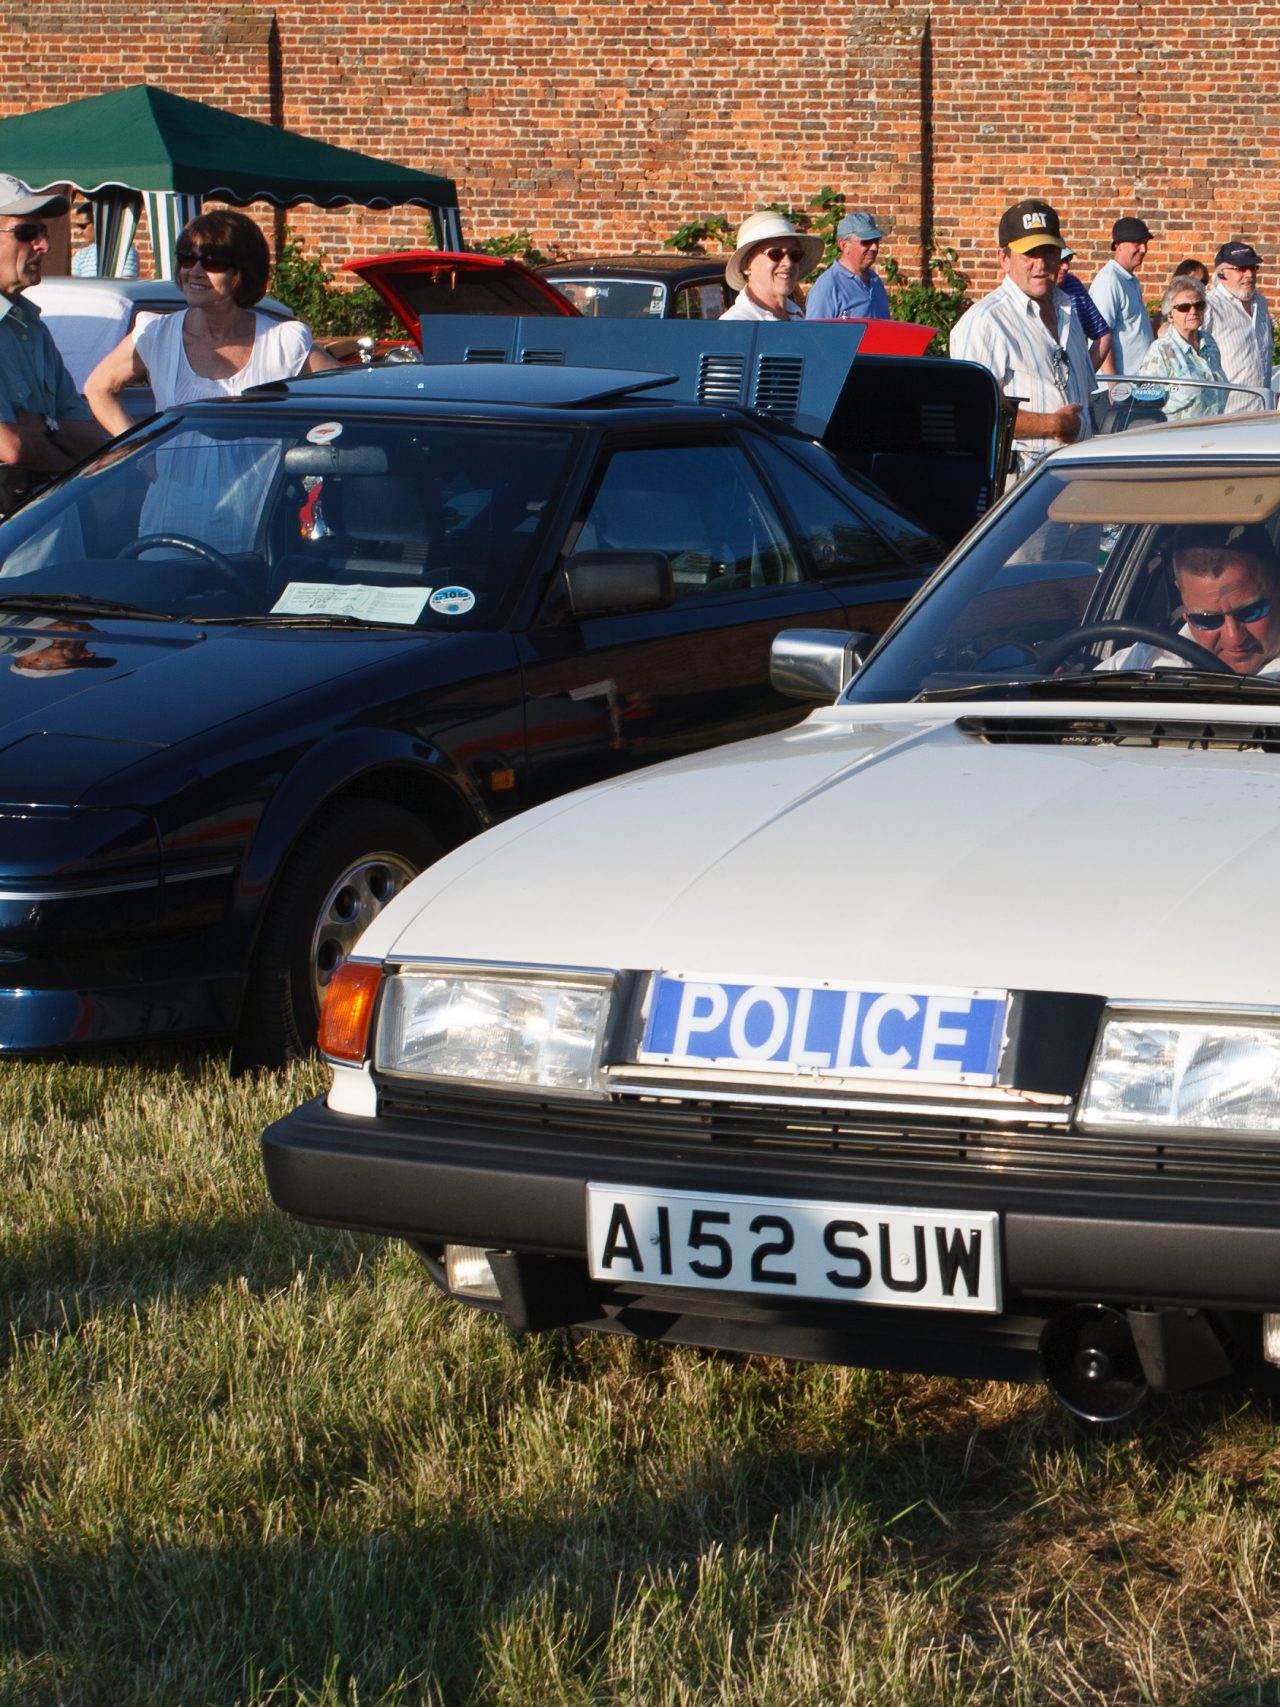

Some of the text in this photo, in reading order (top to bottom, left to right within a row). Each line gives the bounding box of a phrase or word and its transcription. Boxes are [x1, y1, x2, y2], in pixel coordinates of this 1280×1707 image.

[1023, 213, 1047, 229] CAT
[672, 982, 972, 1072] POLICE
[601, 1203, 982, 1298] A152 SUW
